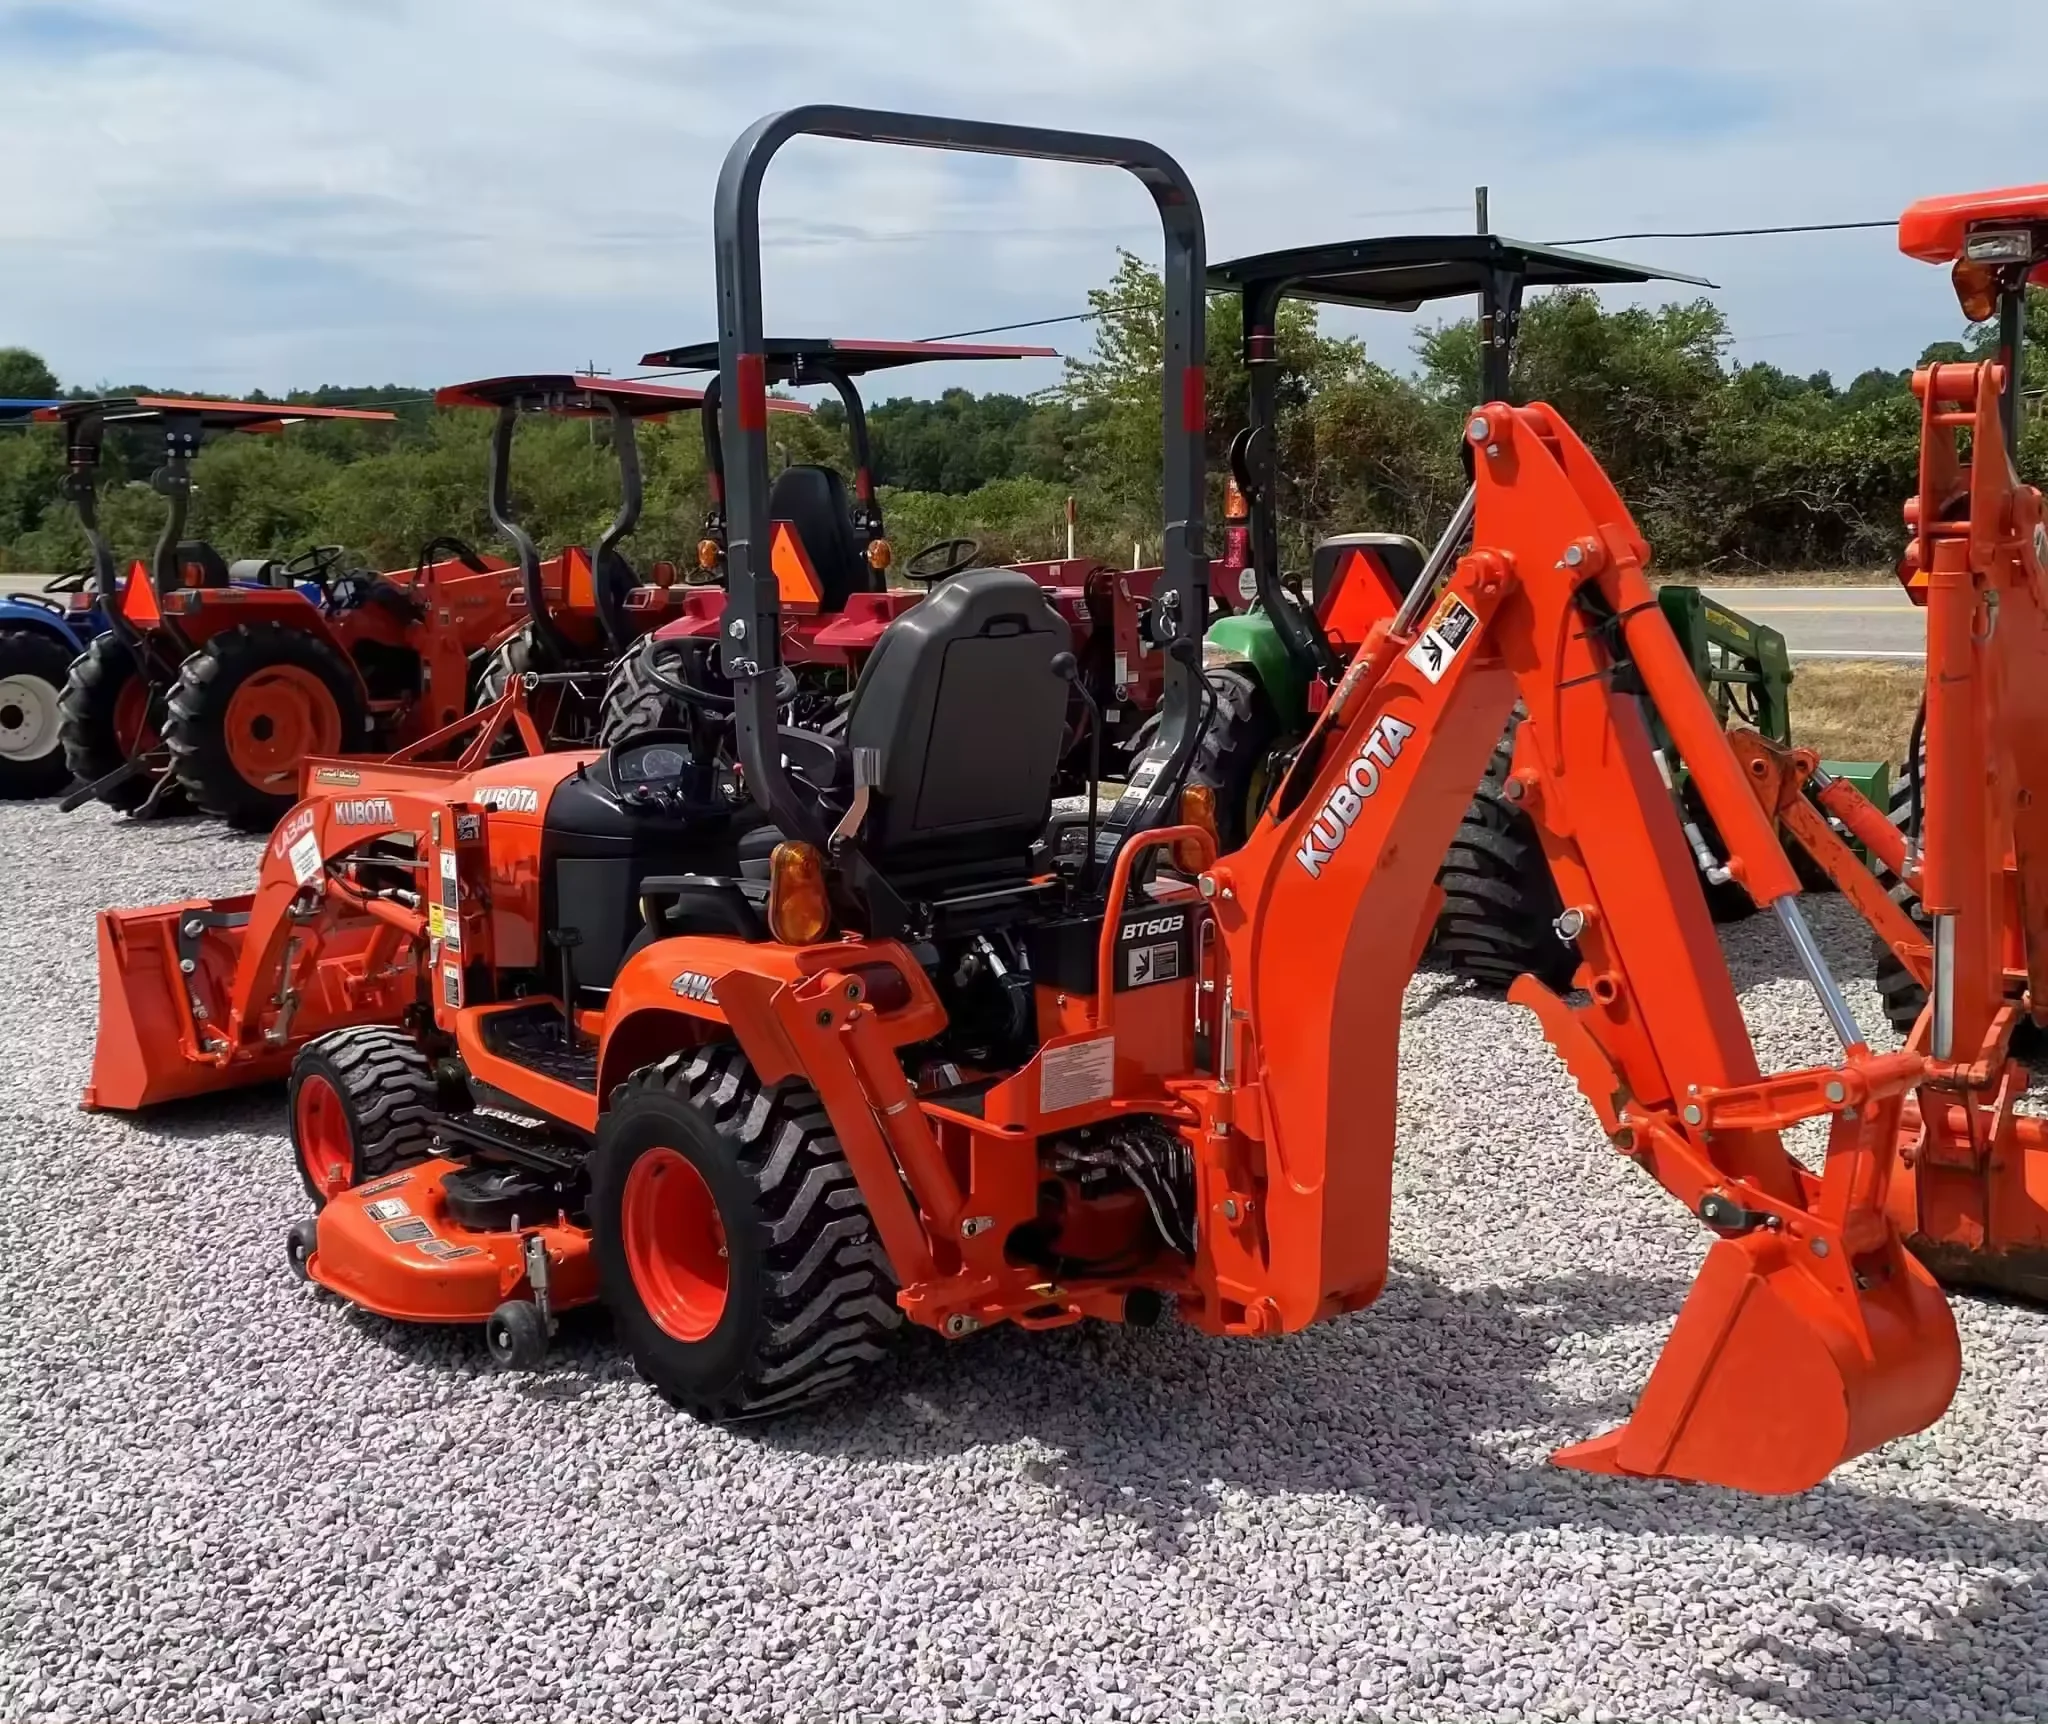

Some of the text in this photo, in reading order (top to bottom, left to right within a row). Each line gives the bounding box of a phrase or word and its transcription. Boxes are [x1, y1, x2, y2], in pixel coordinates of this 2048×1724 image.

[335, 799, 394, 825] KUBOTA
[1296, 714, 1415, 879] KUBOTA
[274, 808, 314, 860] LA340
[1122, 914, 1184, 940] BT603
